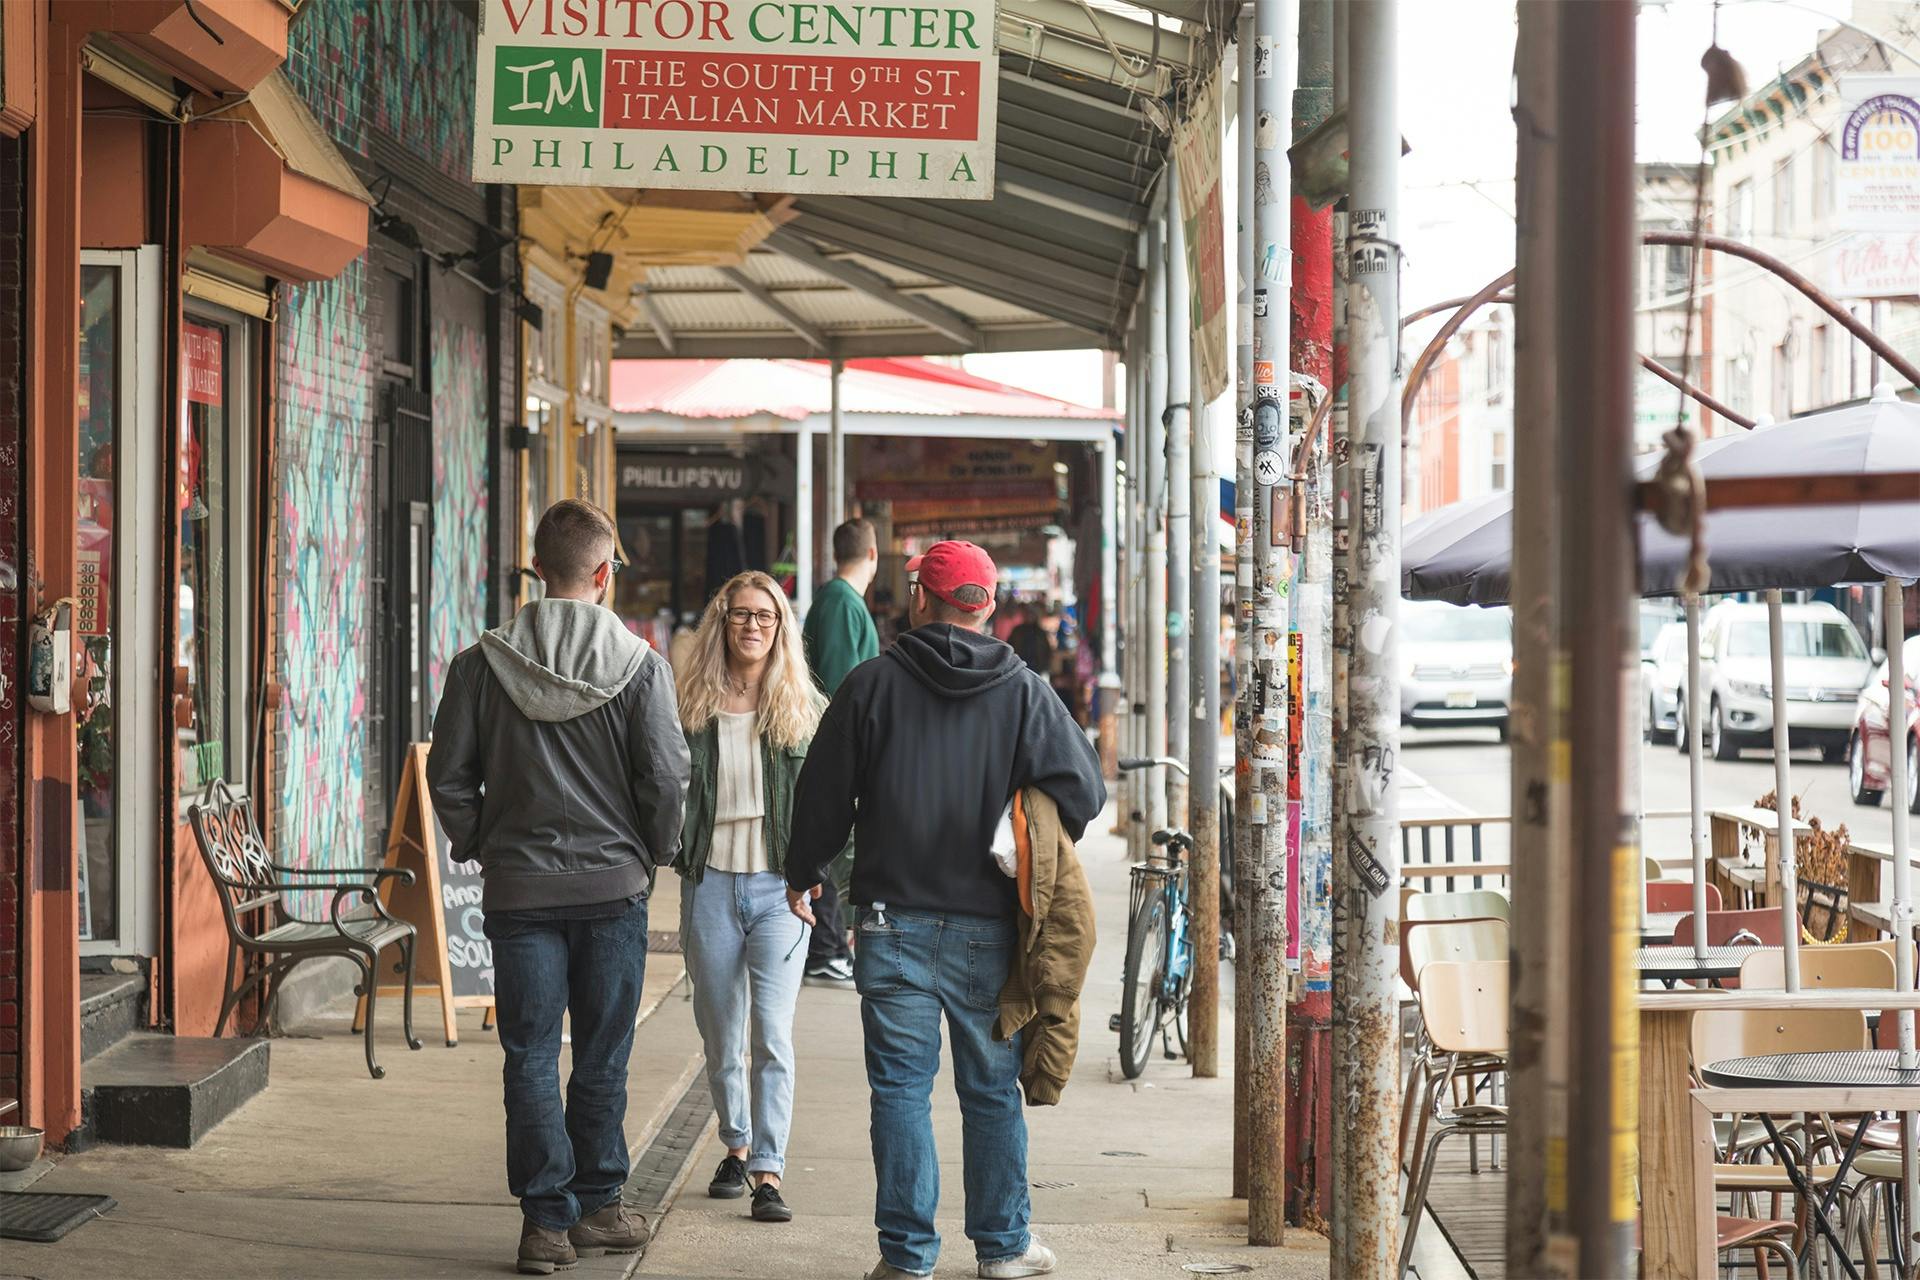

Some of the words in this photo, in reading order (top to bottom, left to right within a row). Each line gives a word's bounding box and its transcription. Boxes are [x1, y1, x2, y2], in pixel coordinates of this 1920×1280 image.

[505, 0, 734, 42] VISITOR
[748, 2, 980, 50] CENTER
[505, 57, 594, 114] IM
[612, 59, 687, 88] THE
[700, 62, 834, 93] SOUTH
[850, 66, 901, 96] 9TH
[914, 68, 966, 97] ST.
[621, 93, 780, 125] ITALIAN
[796, 99, 956, 131] MARKET
[1863, 131, 1913, 151] 100
[491, 138, 977, 183] PHILADELPHIA
[1351, 210, 1386, 225] SOUTH
[442, 883, 483, 910] AND
[447, 934, 493, 969] SOU
